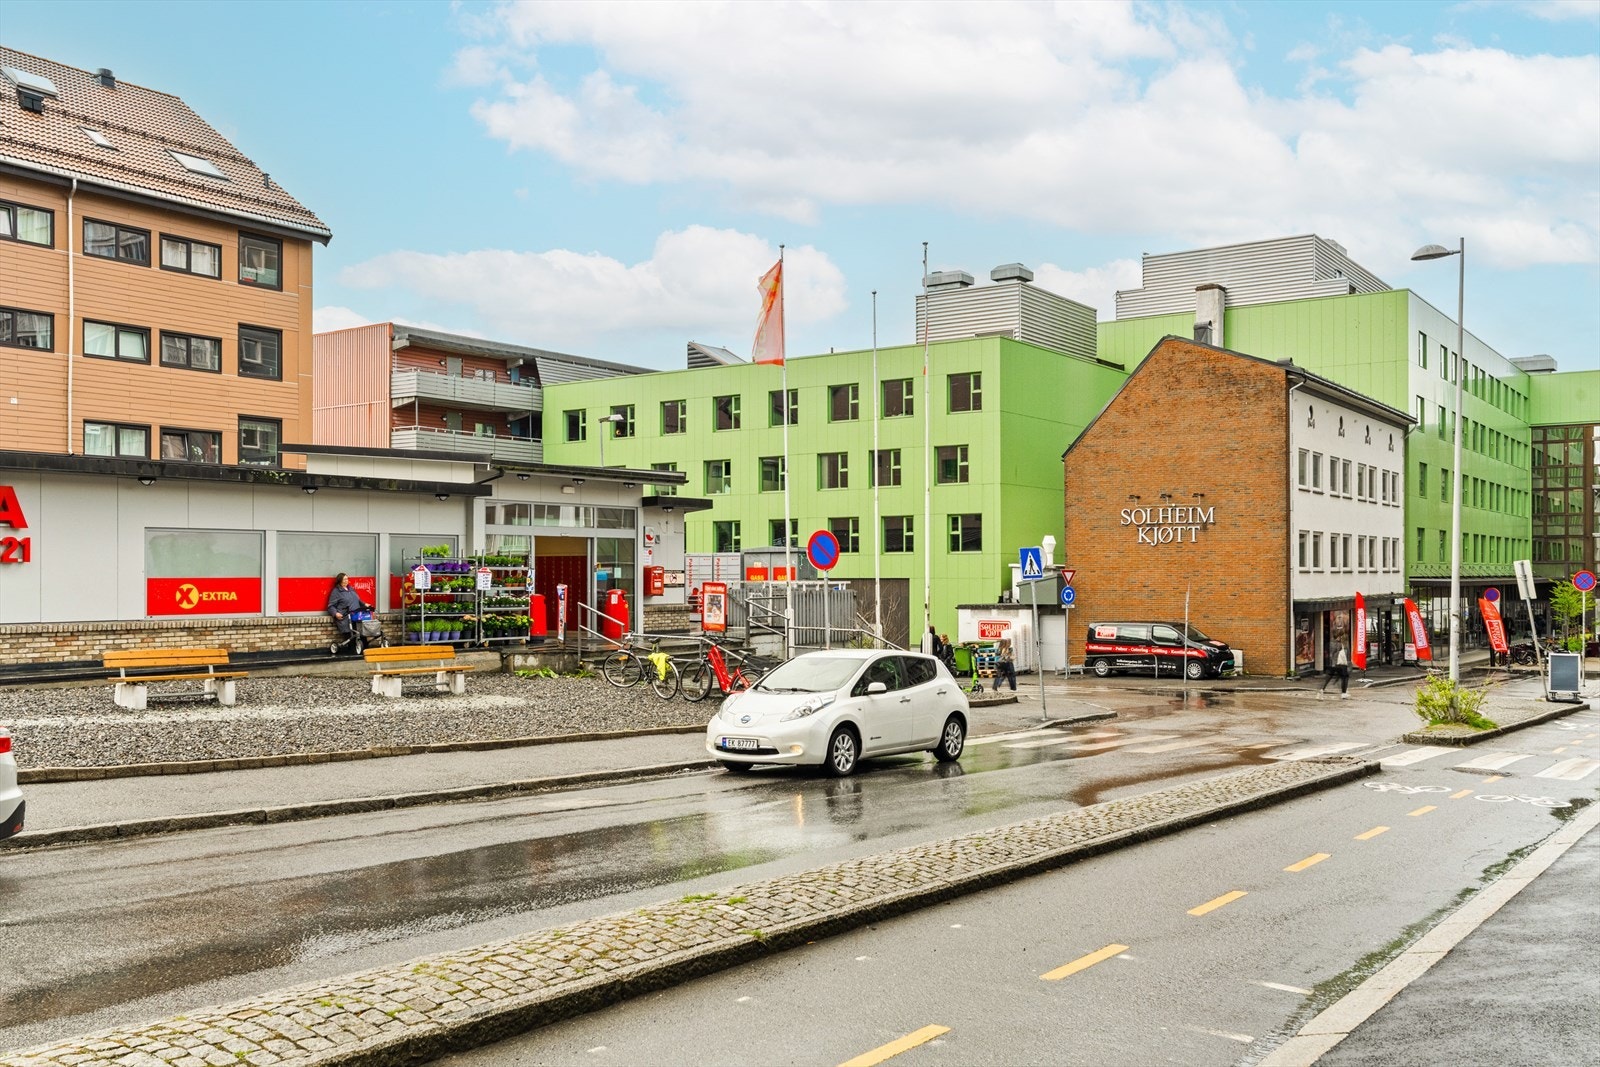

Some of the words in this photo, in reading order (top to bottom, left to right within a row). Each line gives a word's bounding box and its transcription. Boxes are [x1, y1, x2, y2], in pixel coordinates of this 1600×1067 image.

[1120, 506, 1215, 525] SOLHEIM
[1138, 526, 1200, 546] KJØTT
[0, 536, 31, 564] 21
